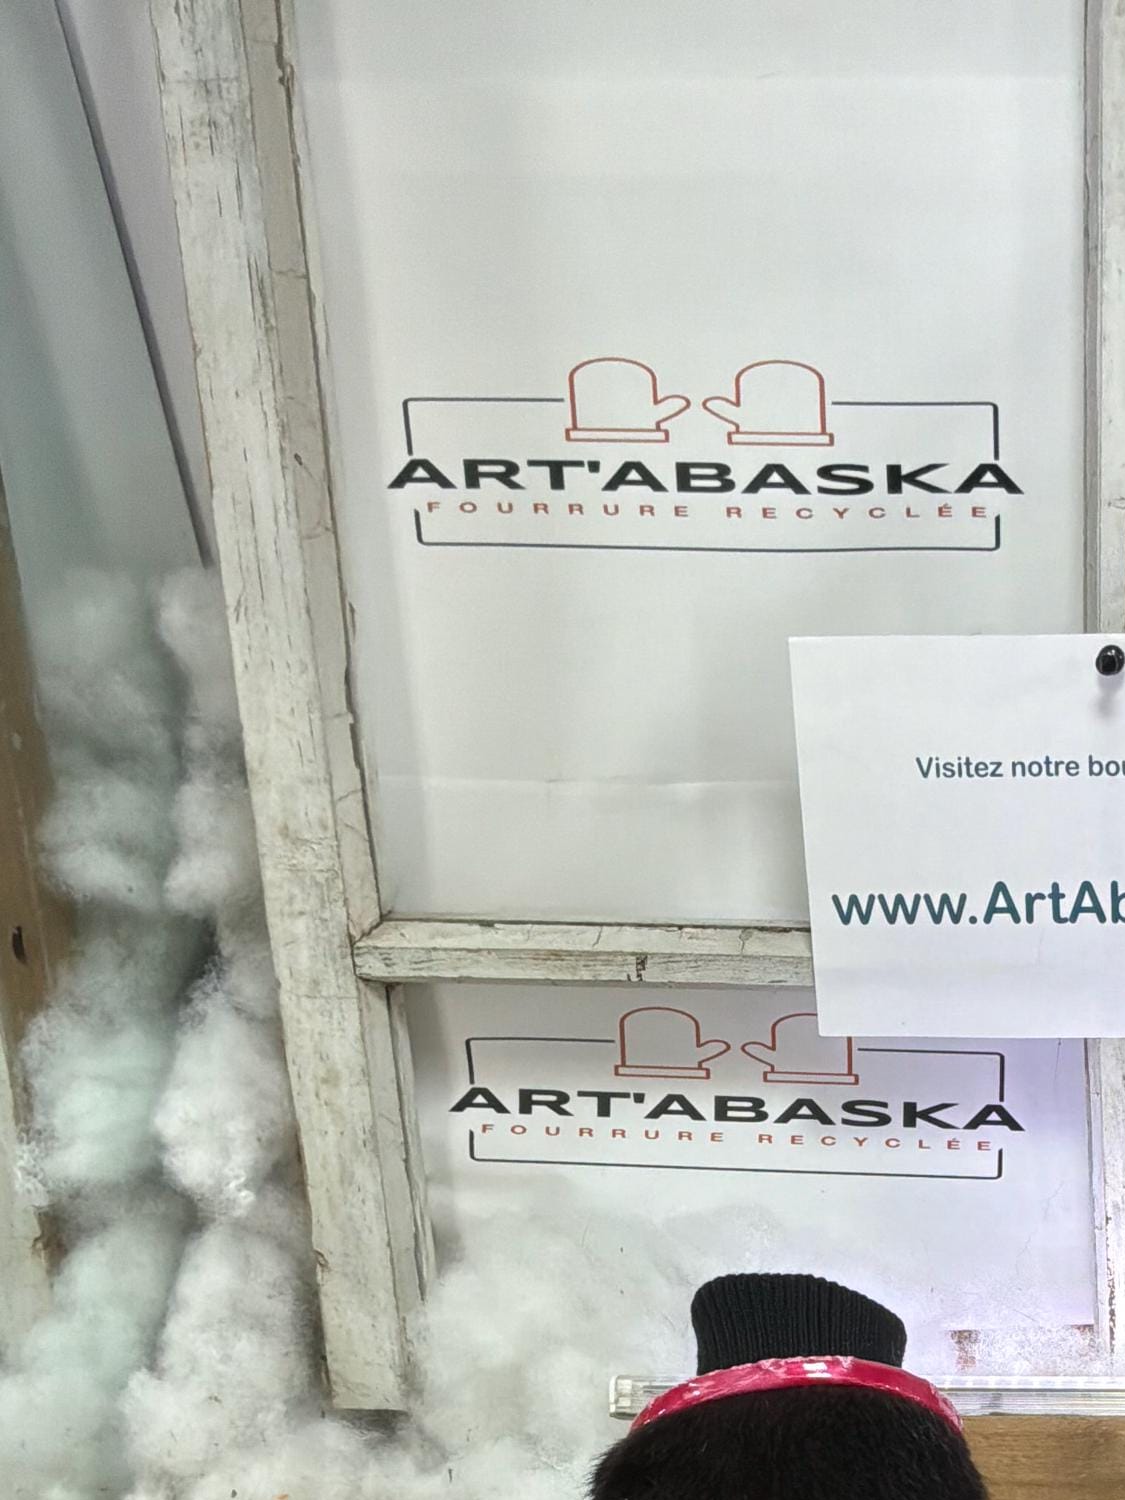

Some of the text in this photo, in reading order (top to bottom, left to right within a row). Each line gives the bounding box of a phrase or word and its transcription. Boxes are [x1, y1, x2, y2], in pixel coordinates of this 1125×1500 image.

[387, 458, 1024, 495] ART'ABASKA
[426, 501, 988, 520] FOURRURE RECYCLÉE
[915, 755, 1004, 779] Visitez
[1010, 755, 1080, 778] notre
[449, 1086, 1025, 1132] ART'ABASKA
[480, 1123, 992, 1151] FOURRURE RECYCLÉE
